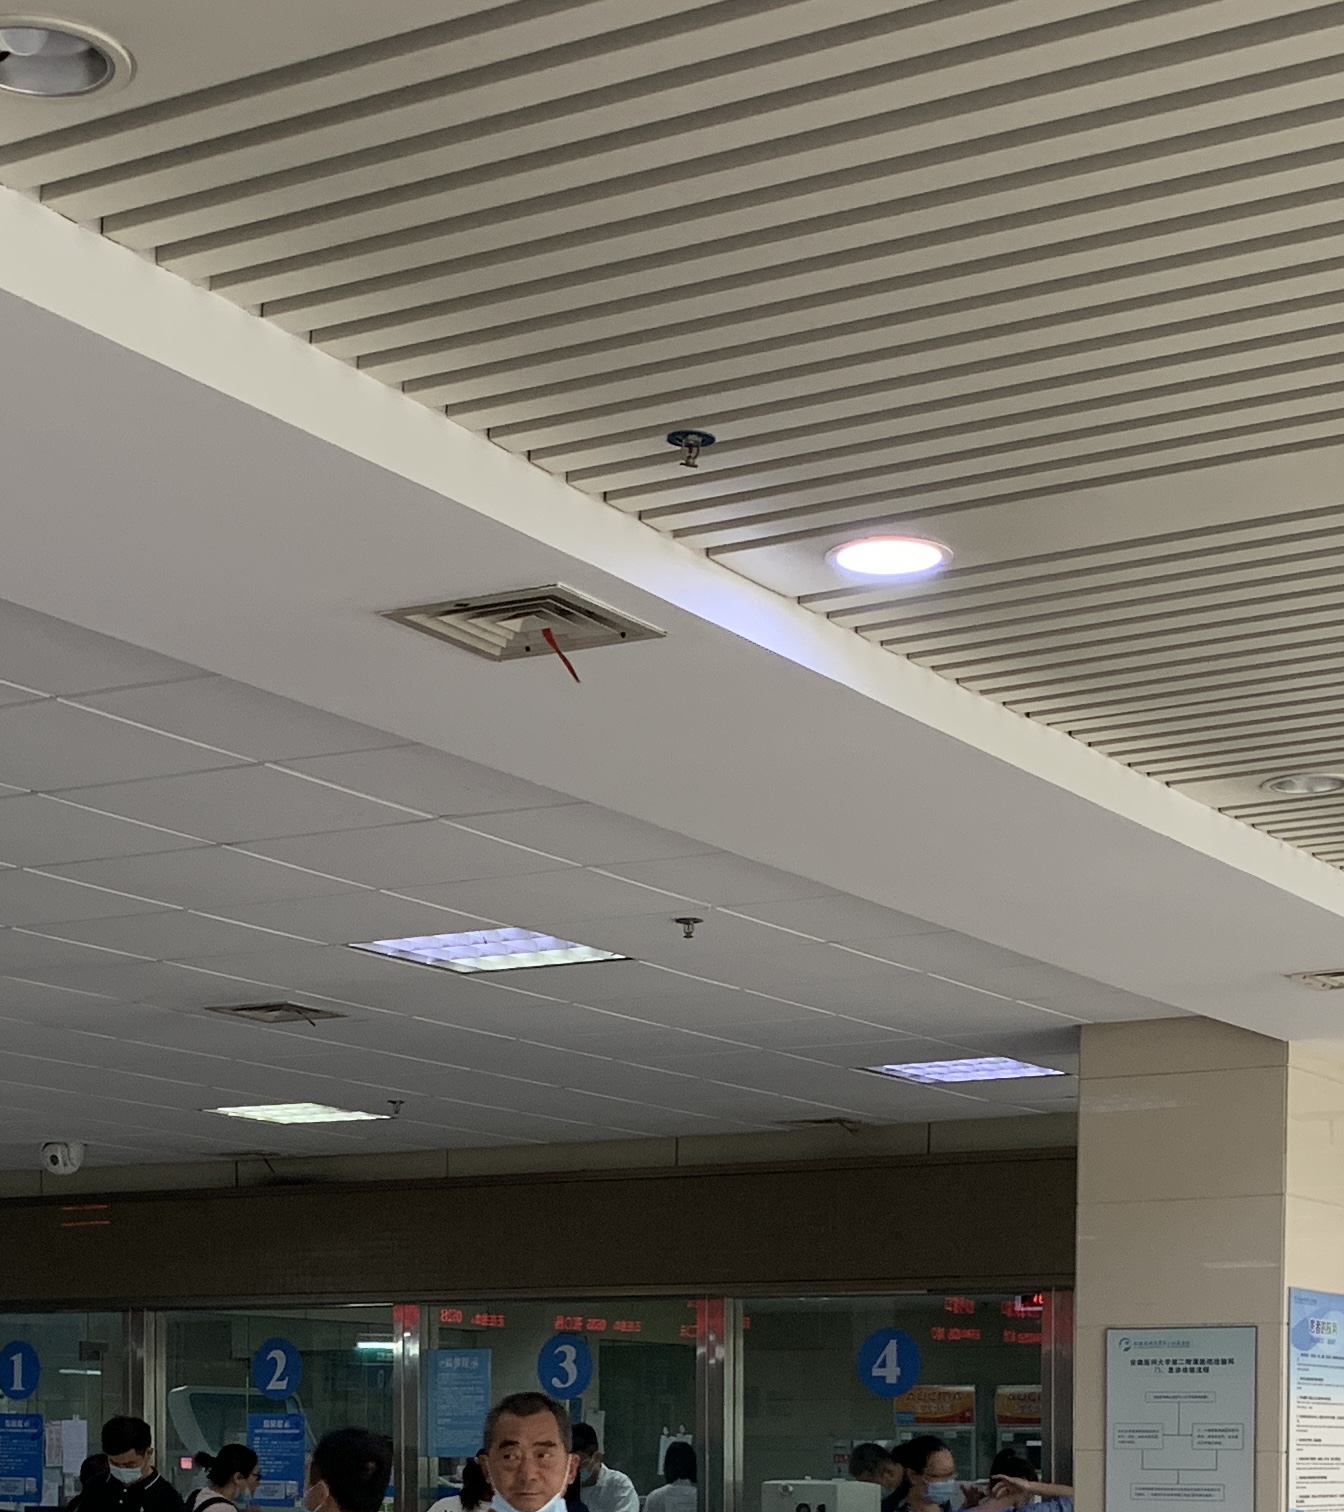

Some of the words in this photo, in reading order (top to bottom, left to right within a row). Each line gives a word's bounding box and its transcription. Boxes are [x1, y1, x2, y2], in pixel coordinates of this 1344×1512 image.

[10, 1352, 26, 1391] 1
[266, 1349, 289, 1390] 2
[551, 1345, 578, 1388] 3
[871, 1339, 901, 1384] 4
